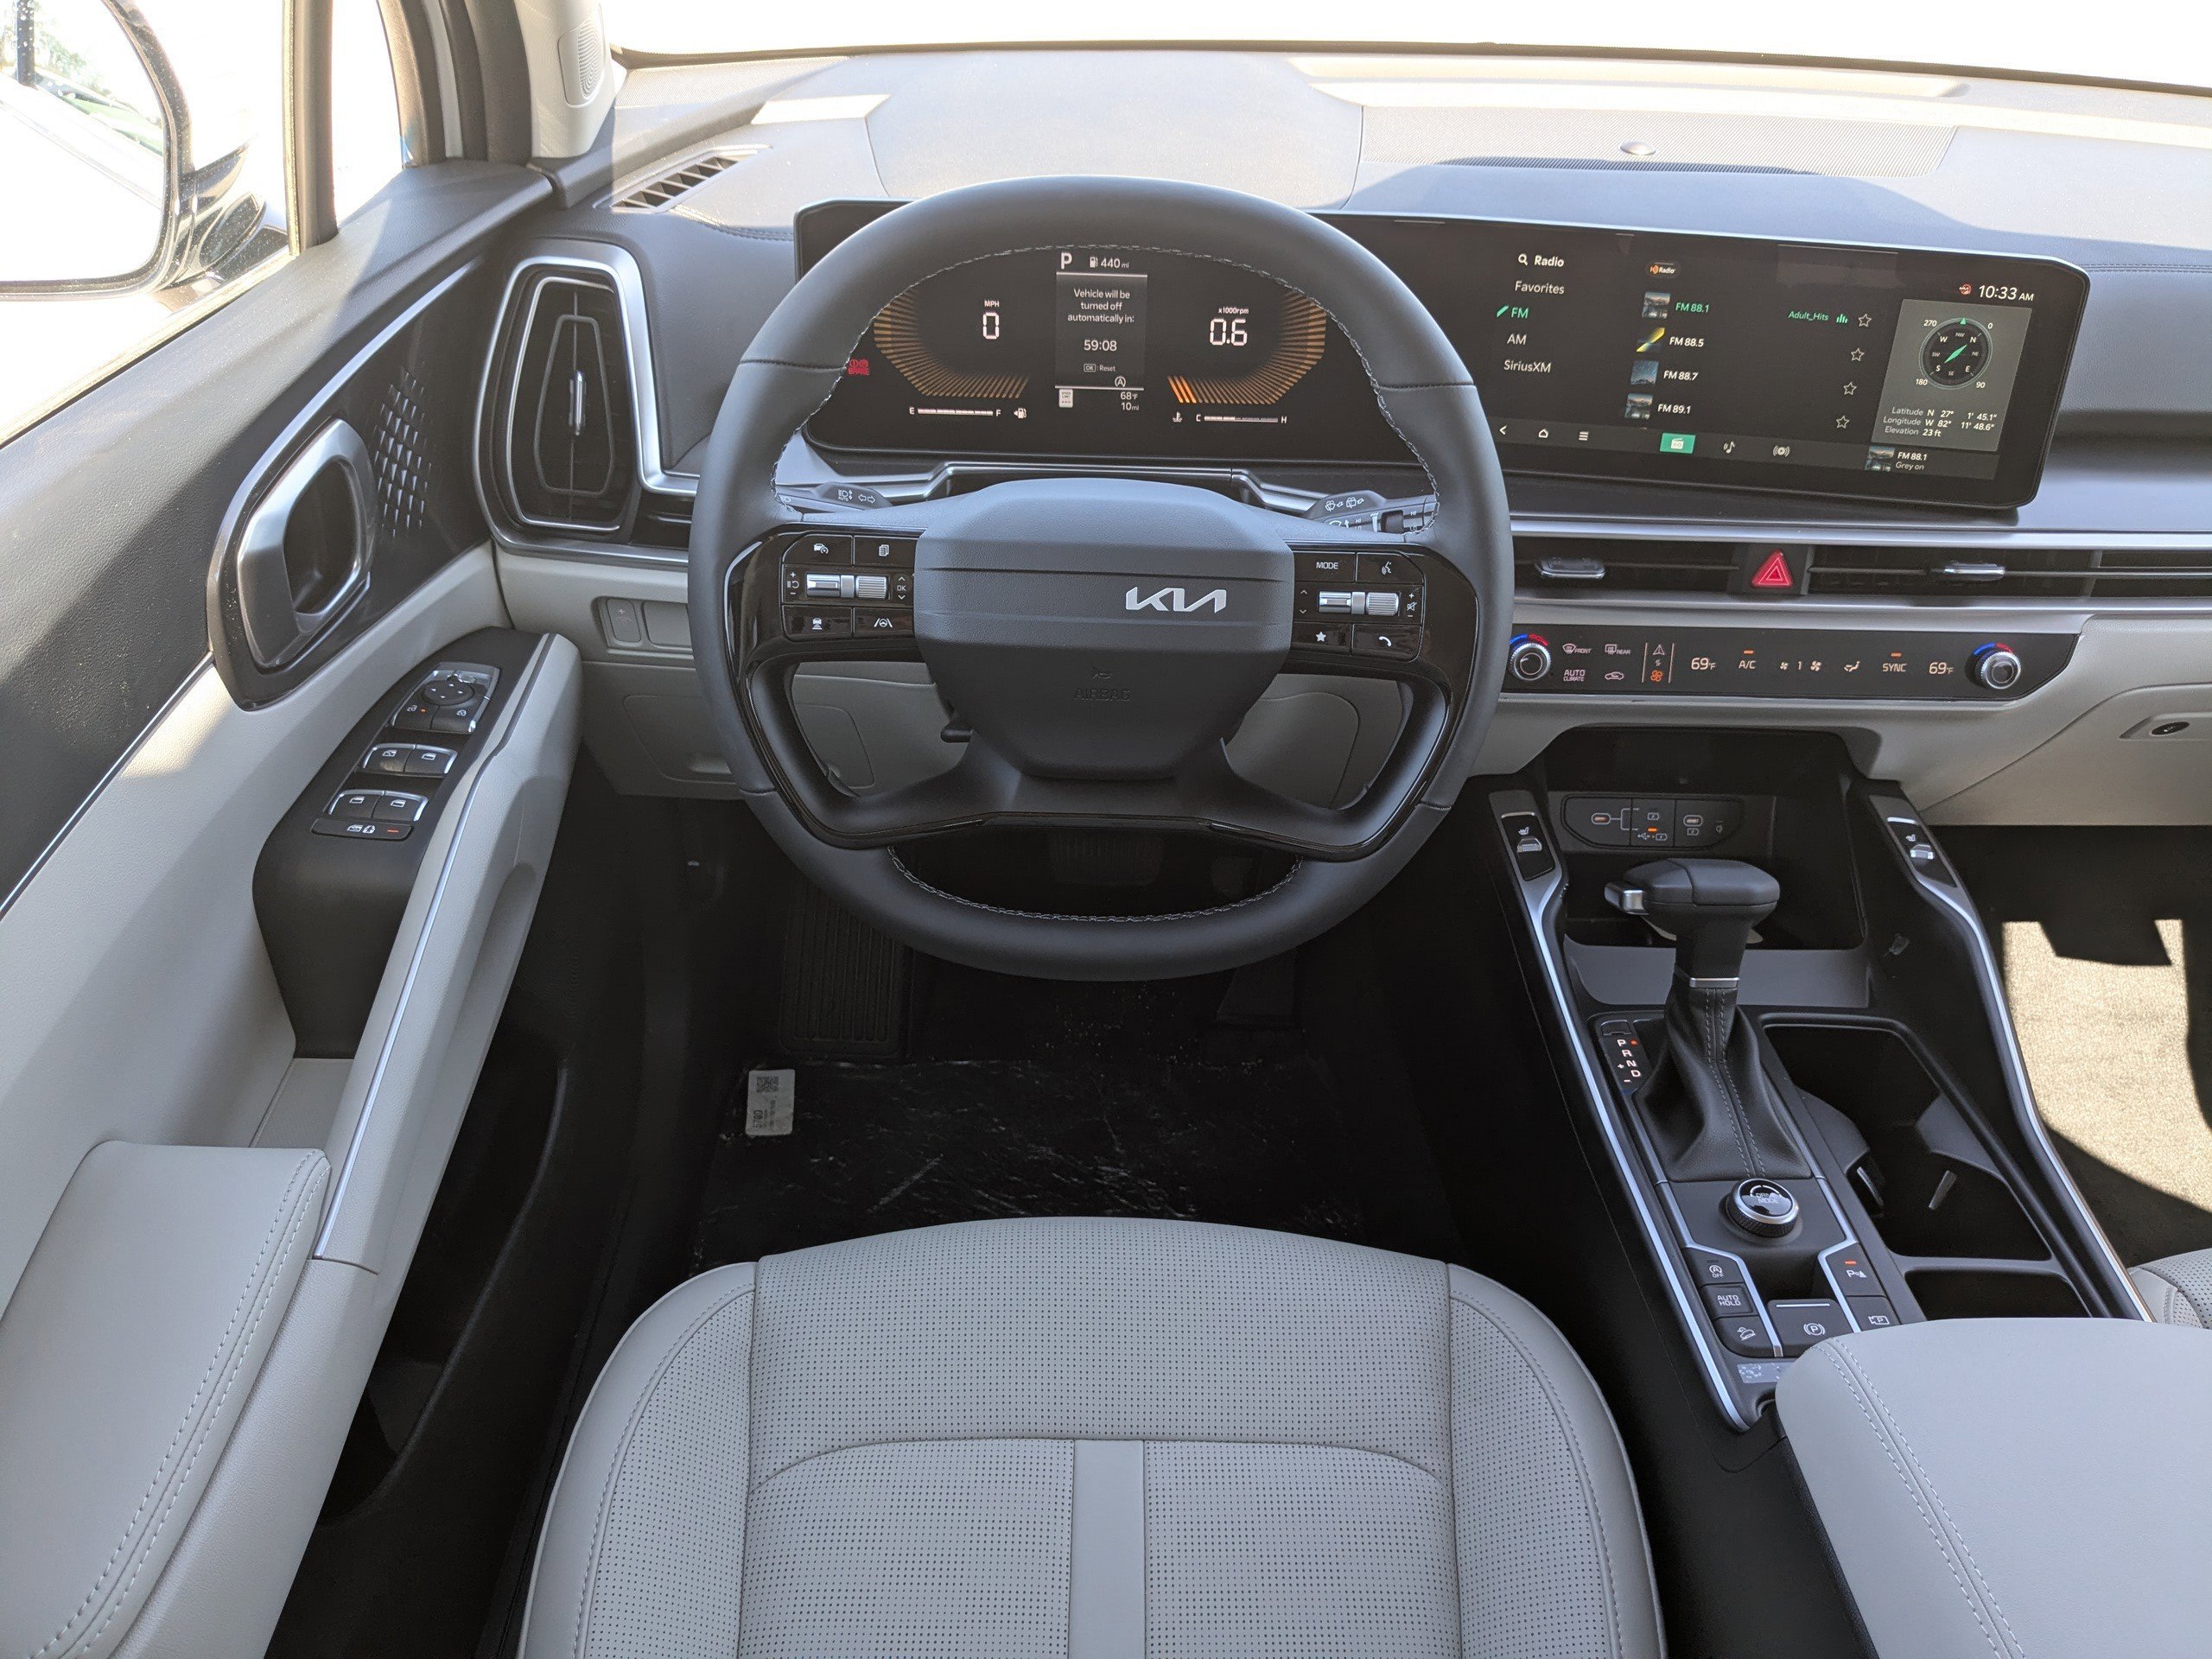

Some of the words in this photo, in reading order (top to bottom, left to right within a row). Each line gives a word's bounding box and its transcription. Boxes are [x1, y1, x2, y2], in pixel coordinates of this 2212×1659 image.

[1061, 252, 1072, 270] P
[1101, 258, 1121, 269] 440
[1534, 254, 1565, 267] Radio
[1515, 280, 1565, 295] Favorites
[1979, 284, 2018, 301] 10:33
[2018, 292, 2035, 302] AM
[1074, 289, 1103, 298] Vehicle
[1105, 289, 1118, 299] will
[1119, 290, 1130, 299] be
[1217, 307, 1249, 315] x1000rpm
[1510, 307, 1529, 319] FM
[1675, 302, 1690, 312] FM
[1691, 303, 1710, 314] 88.1
[1067, 315, 1123, 324] automatically
[1125, 315, 1135, 323] in:
[1923, 319, 1937, 327] 270
[982, 312, 1000, 340] 0
[1210, 318, 1248, 346] 0.6
[1507, 333, 1527, 345] AM
[1669, 336, 1683, 346] FM
[1684, 337, 1705, 347] 88.5
[1084, 340, 1117, 352] 59:08
[1503, 359, 1552, 373] SiriusXM
[1663, 370, 1678, 380] FM
[1678, 371, 1699, 381] 88.7
[909, 406, 915, 415] E
[1657, 404, 1672, 413] FM
[1672, 404, 1692, 415] 89.1
[1891, 407, 1923, 416] Latitude
[1883, 416, 1922, 427] Longitude
[1885, 425, 1919, 435] Elevation
[1910, 453, 1928, 461] 88.1
[1895, 461, 1914, 471] Grey
[1316, 562, 1338, 570] MODE
[1125, 586, 1227, 613] KIA
[1738, 659, 1757, 670] A/C
[1882, 663, 1907, 673] SYNC
[1617, 1039, 1626, 1047] P
[1622, 1049, 1632, 1058] R
